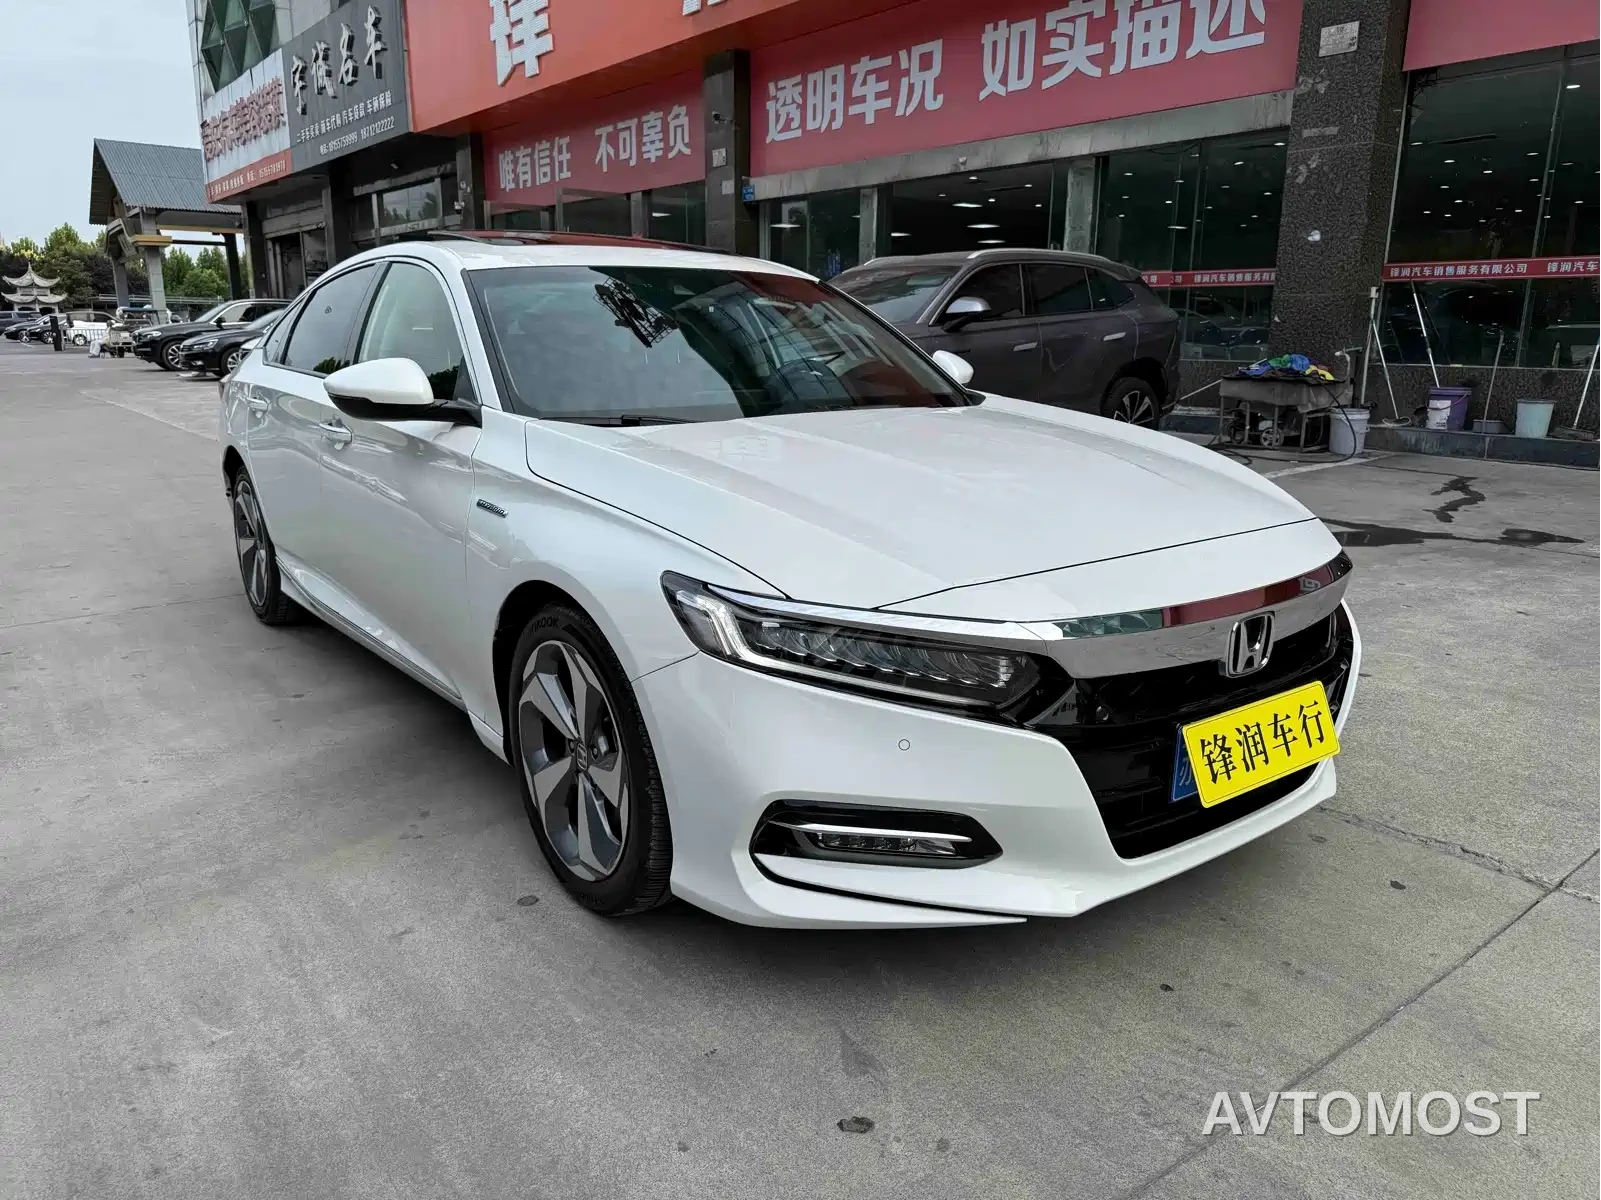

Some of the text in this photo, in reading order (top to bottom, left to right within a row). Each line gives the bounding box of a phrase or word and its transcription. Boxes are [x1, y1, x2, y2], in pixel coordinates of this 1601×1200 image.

[766, 38, 944, 144] 透明车况
[979, 0, 1266, 101] 如实描述
[499, 104, 692, 193] 唯有信任 不可辜负
[1390, 263, 1528, 278] 锋润汽车销售服务有限公司
[1200, 700, 1325, 784] 锋润车行
